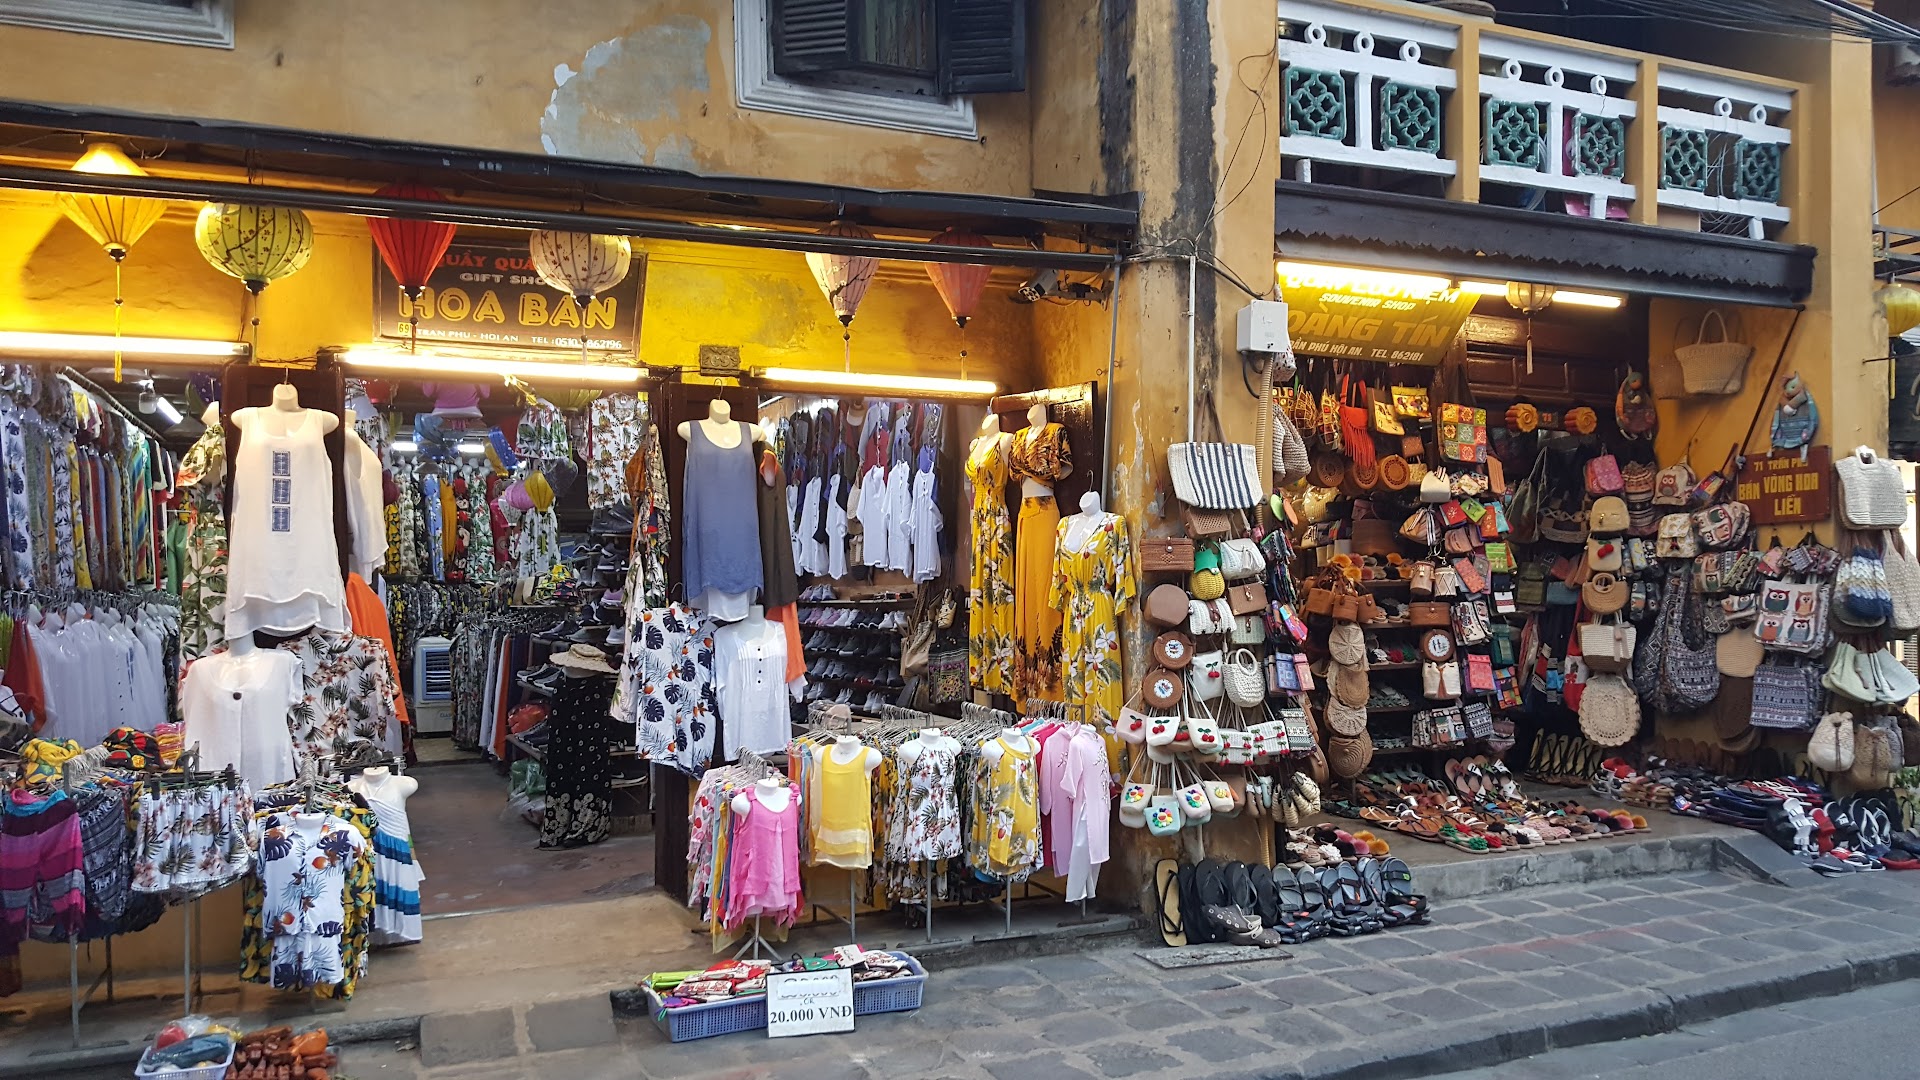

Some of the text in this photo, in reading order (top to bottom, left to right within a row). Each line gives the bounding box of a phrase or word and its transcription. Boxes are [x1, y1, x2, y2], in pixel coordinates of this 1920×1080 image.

[459, 272, 548, 287] GIFT SHO
[398, 286, 618, 330] HOA BAN
[1318, 292, 1416, 311] SOUVENIR SHOP
[1287, 301, 1383, 342] OÀNG
[398, 323, 410, 333] 69
[531, 336, 549, 344] TEL
[1307, 340, 1330, 353] PHÚ
[1390, 350, 1424, 362] 862181
[1753, 460, 1764, 472] 71
[1795, 472, 1819, 491] HOA
[769, 1008, 814, 1024] 20.000
